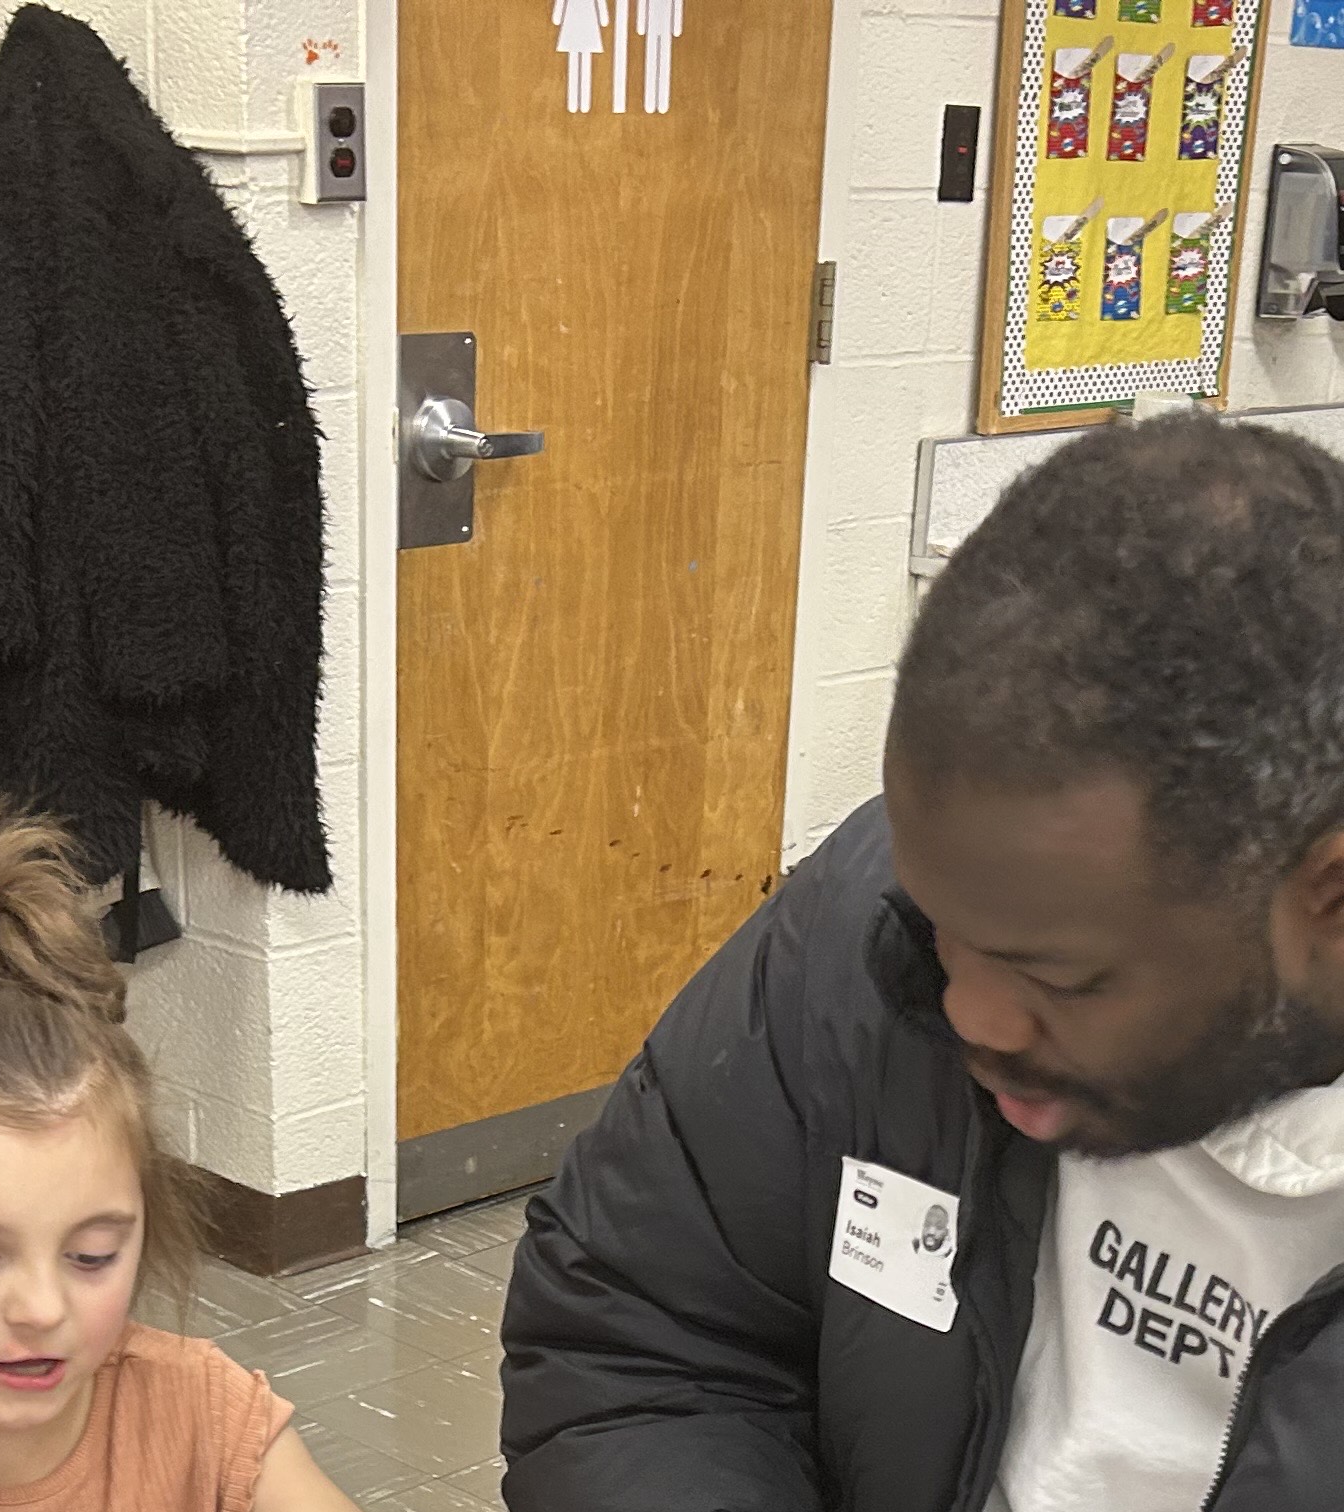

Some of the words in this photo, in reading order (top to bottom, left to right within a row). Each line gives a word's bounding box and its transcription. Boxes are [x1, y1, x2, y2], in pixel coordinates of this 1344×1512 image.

[841, 1240, 885, 1273] Brinson
[845, 1219, 881, 1249] Isaiah
[1088, 1219, 1269, 1346] GALLERY
[1096, 1286, 1236, 1379] DEPT
